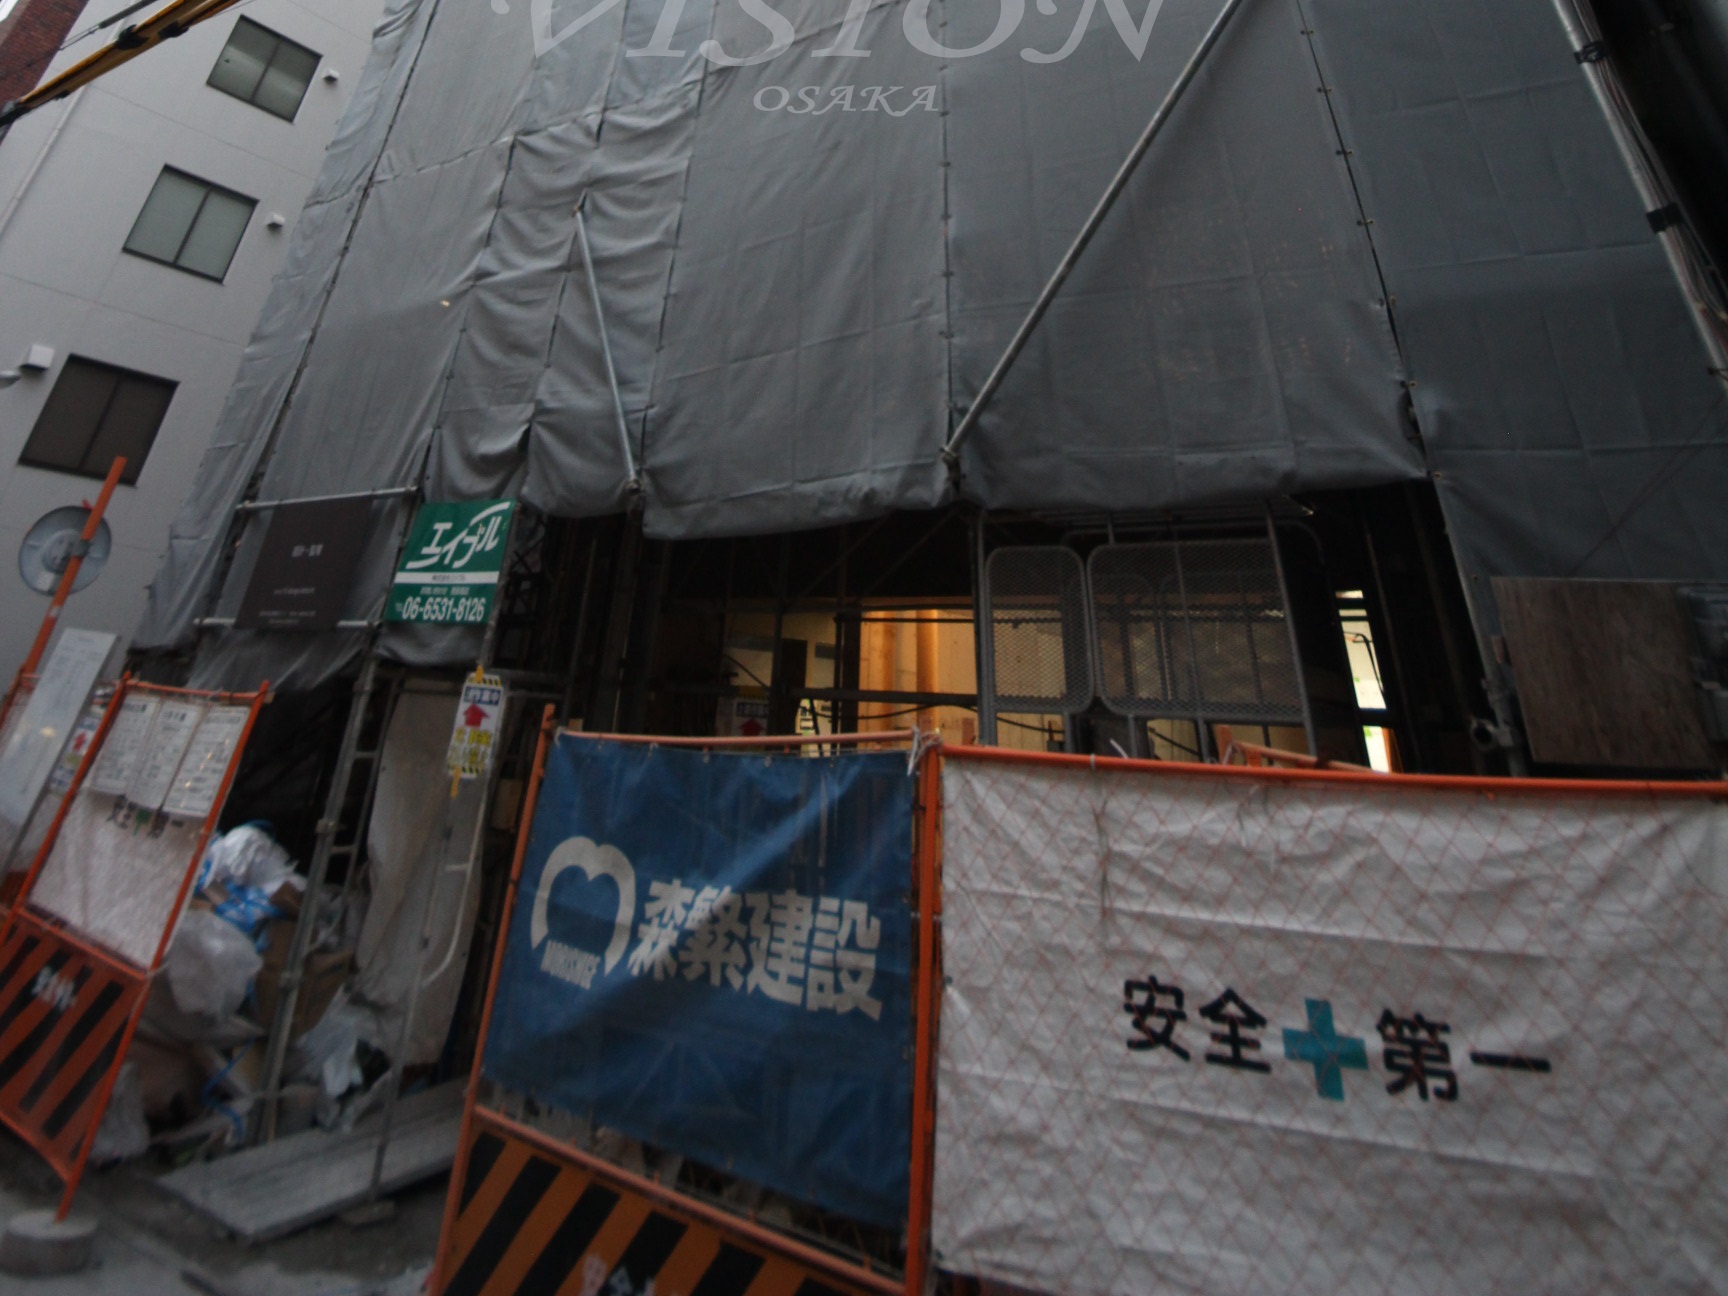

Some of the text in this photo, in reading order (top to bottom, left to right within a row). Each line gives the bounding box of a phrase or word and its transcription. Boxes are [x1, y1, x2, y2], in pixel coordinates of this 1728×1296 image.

[418, 511, 503, 569] エイブル
[401, 595, 486, 622] 06-6531-8126
[627, 878, 882, 1022] 森繁建設
[1123, 974, 1551, 1101] 安全 第一
